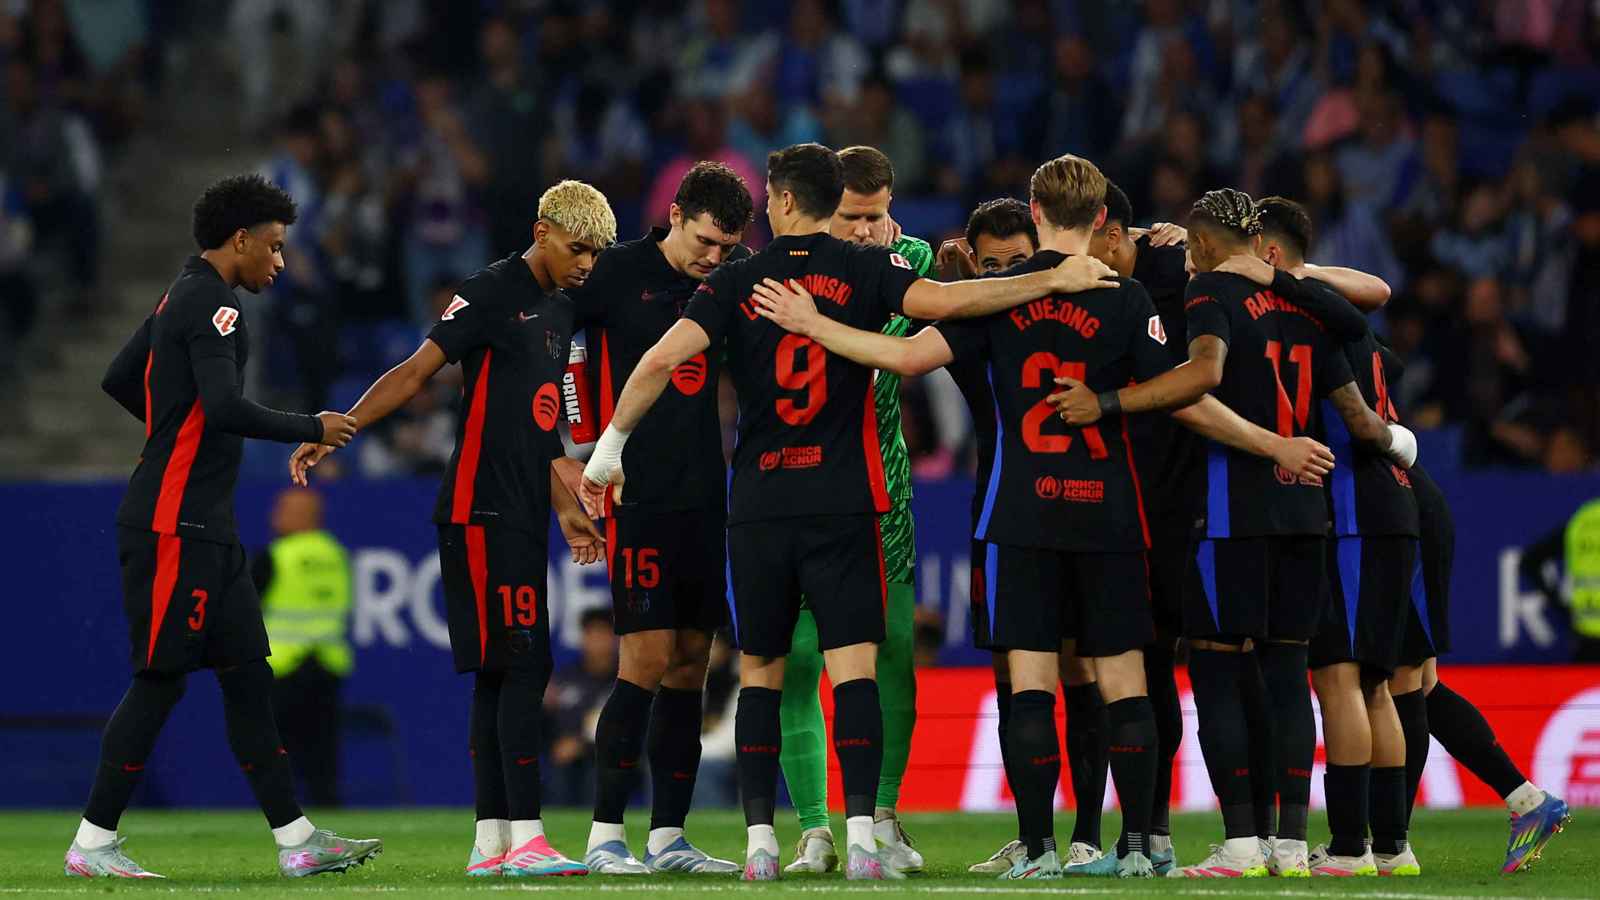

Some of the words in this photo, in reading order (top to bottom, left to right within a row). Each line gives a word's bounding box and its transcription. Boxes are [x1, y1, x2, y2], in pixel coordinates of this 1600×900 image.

[563, 372, 582, 424] PRIME
[775, 334, 827, 426] 9
[1264, 340, 1313, 438] 11
[1022, 351, 1108, 460] 21
[1063, 479, 1104, 489] UNHCR
[620, 547, 662, 589] 15
[187, 587, 208, 631] 3
[496, 584, 539, 628] 19
